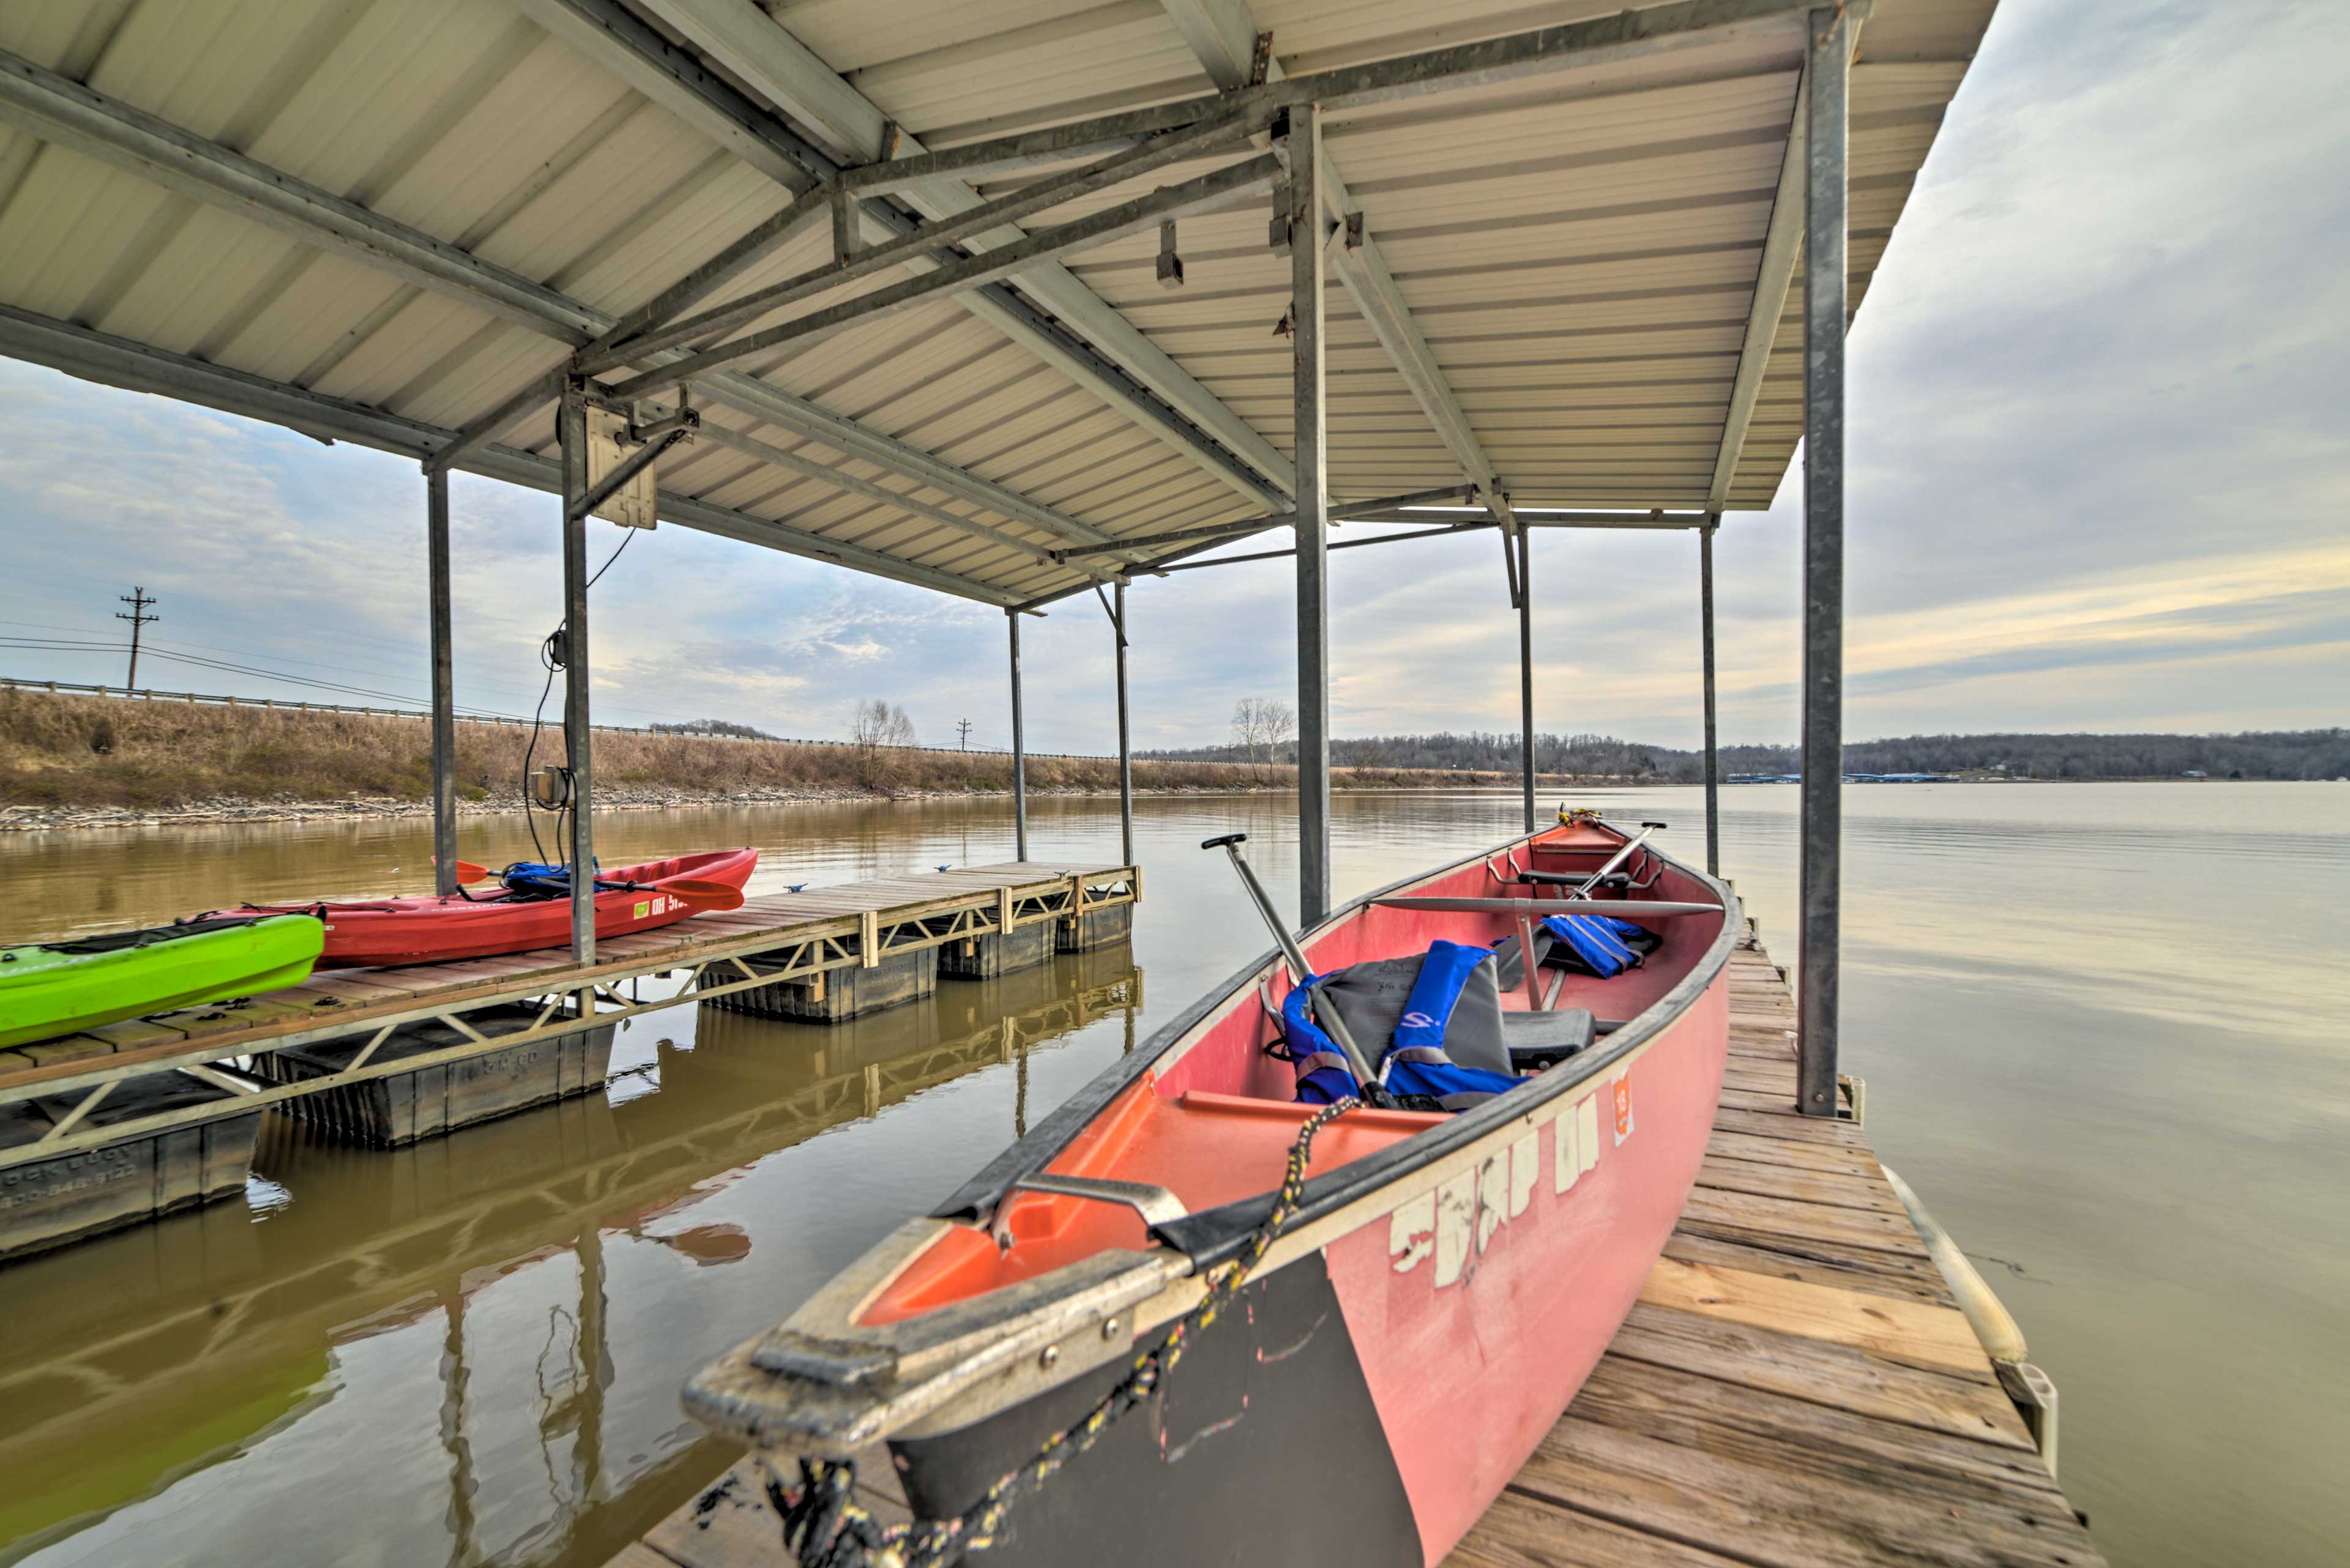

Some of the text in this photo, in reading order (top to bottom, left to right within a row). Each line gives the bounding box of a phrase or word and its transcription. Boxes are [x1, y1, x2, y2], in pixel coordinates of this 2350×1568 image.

[652, 897, 665, 916] OH
[0, 1144, 135, 1187] OCK BUOY
